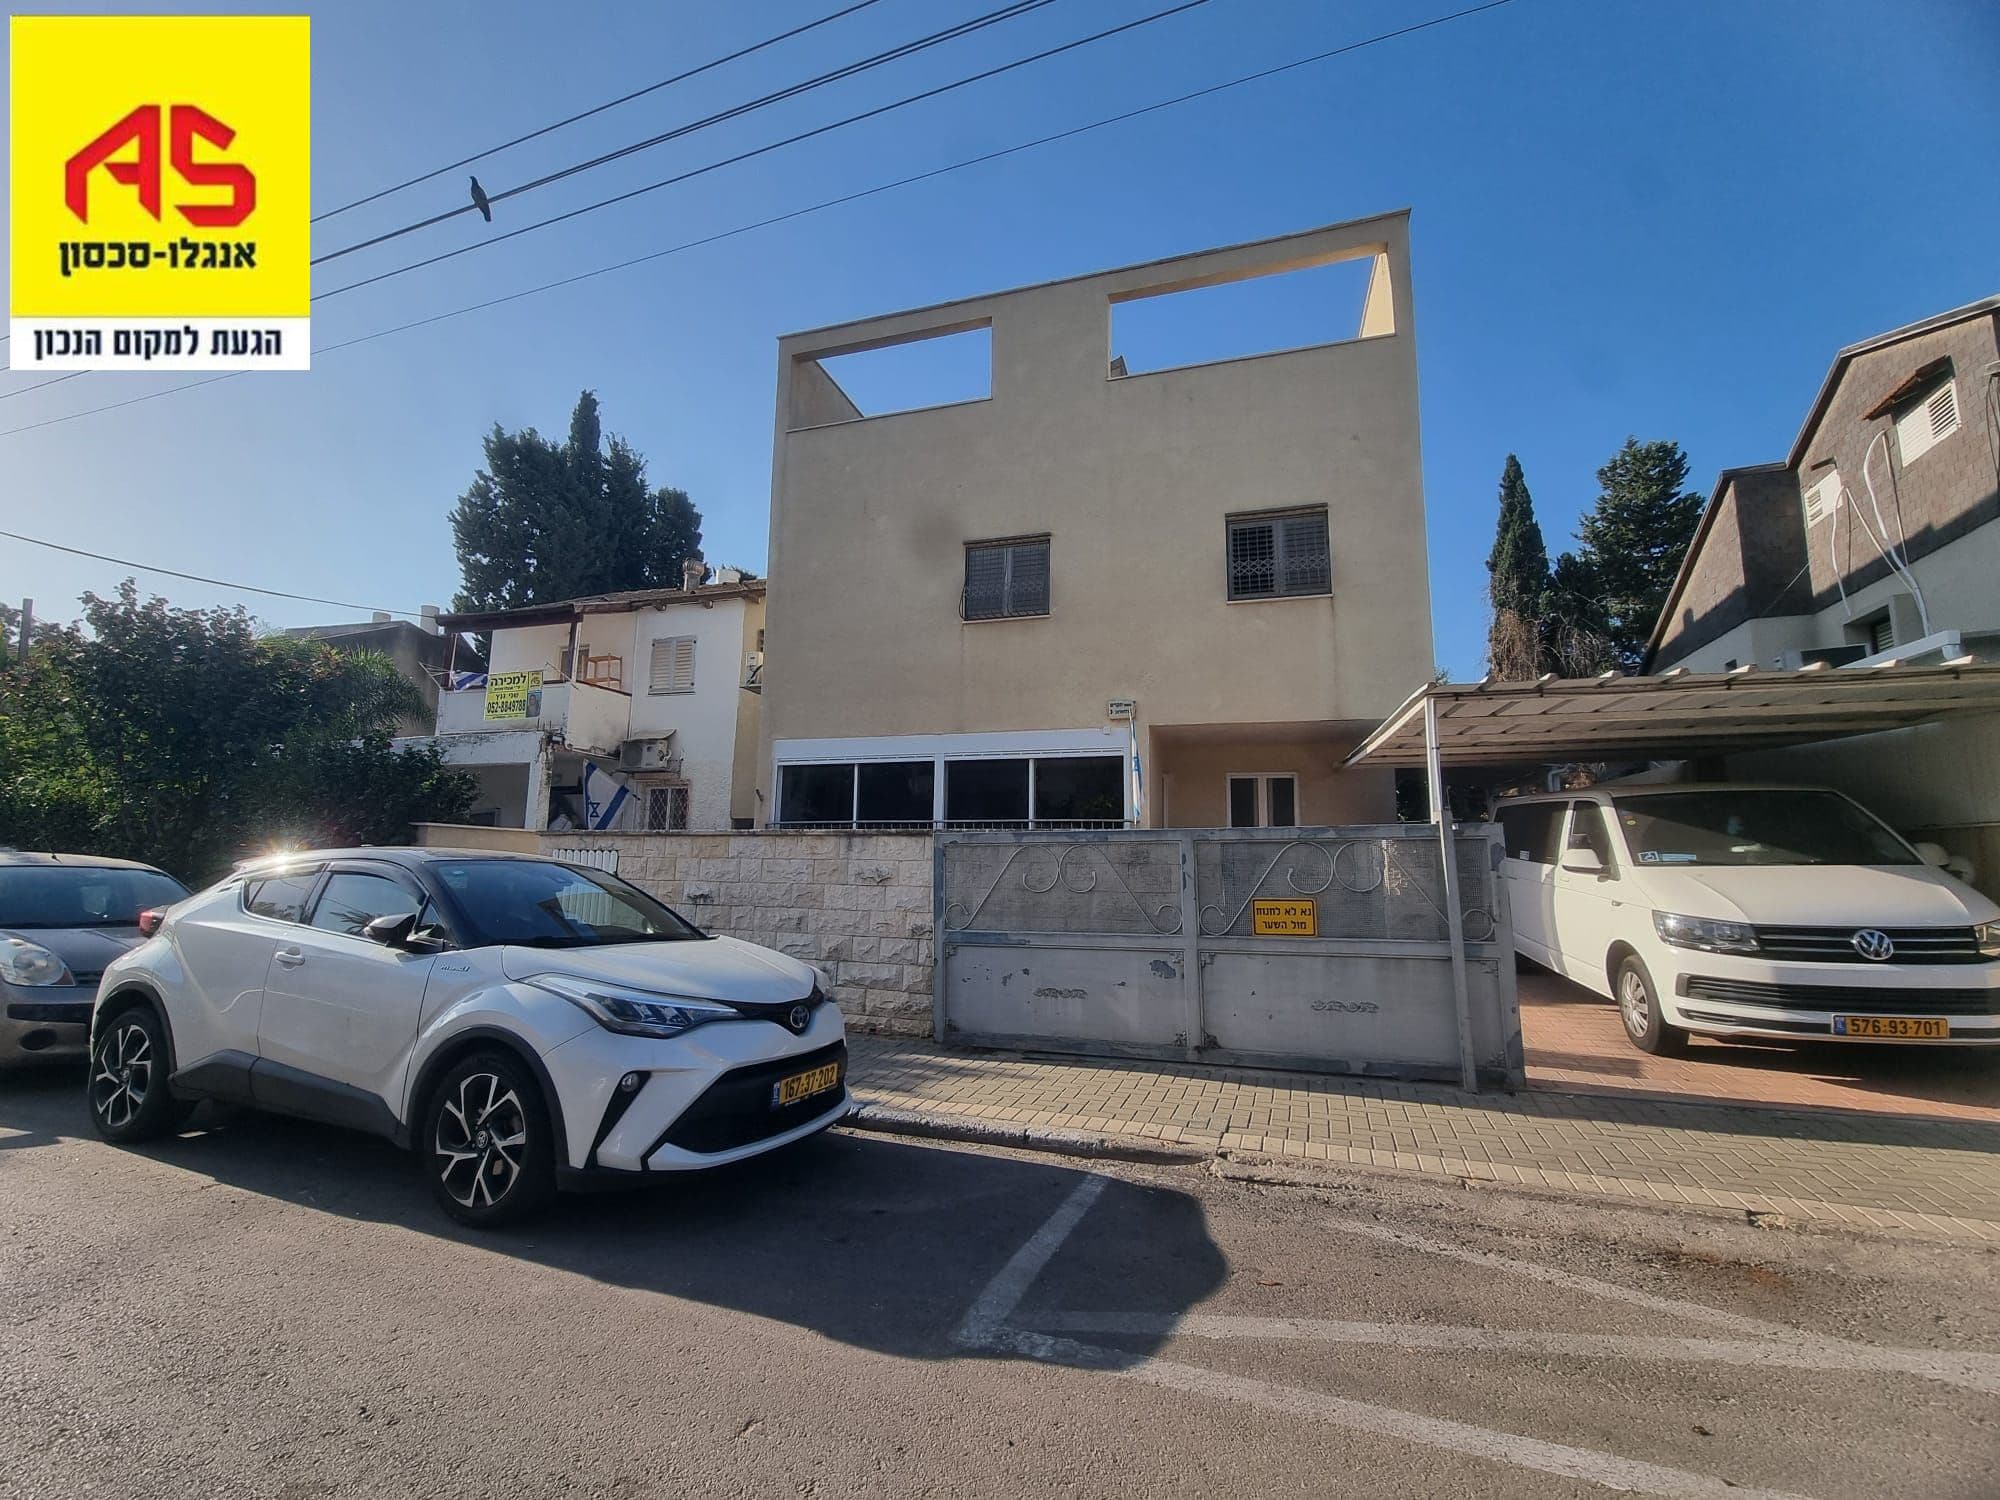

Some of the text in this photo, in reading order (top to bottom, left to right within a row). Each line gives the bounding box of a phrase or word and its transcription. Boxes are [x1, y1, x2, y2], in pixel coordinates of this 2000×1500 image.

[491, 673, 527, 687] למכירה
[1284, 906, 1297, 916] לא
[1300, 907, 1312, 916] נא
[1262, 920, 1307, 929] מול השער
